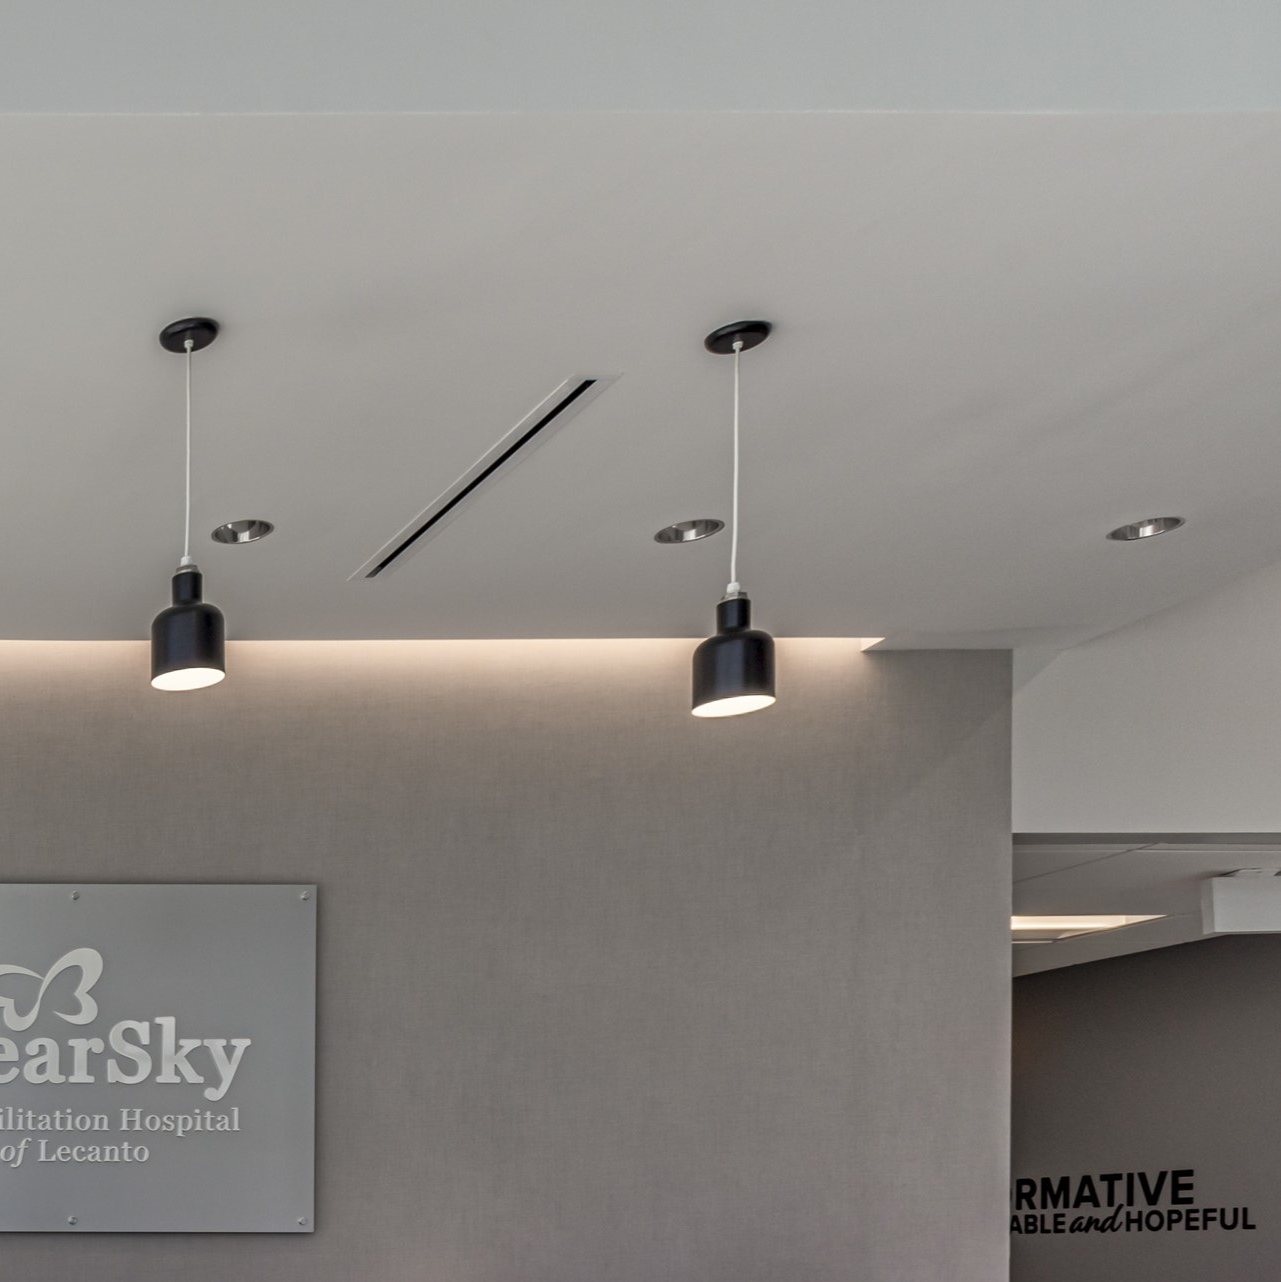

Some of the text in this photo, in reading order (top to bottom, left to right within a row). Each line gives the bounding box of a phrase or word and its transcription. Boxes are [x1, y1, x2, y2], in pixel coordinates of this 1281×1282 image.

[119, 1107, 241, 1137] Hospital
[0, 1137, 150, 1168] of Lecanto
[1011, 1169, 1195, 1210] RMATIVE
[1069, 1203, 1124, 1234] and
[1125, 1207, 1256, 1232] HOPEFUL
